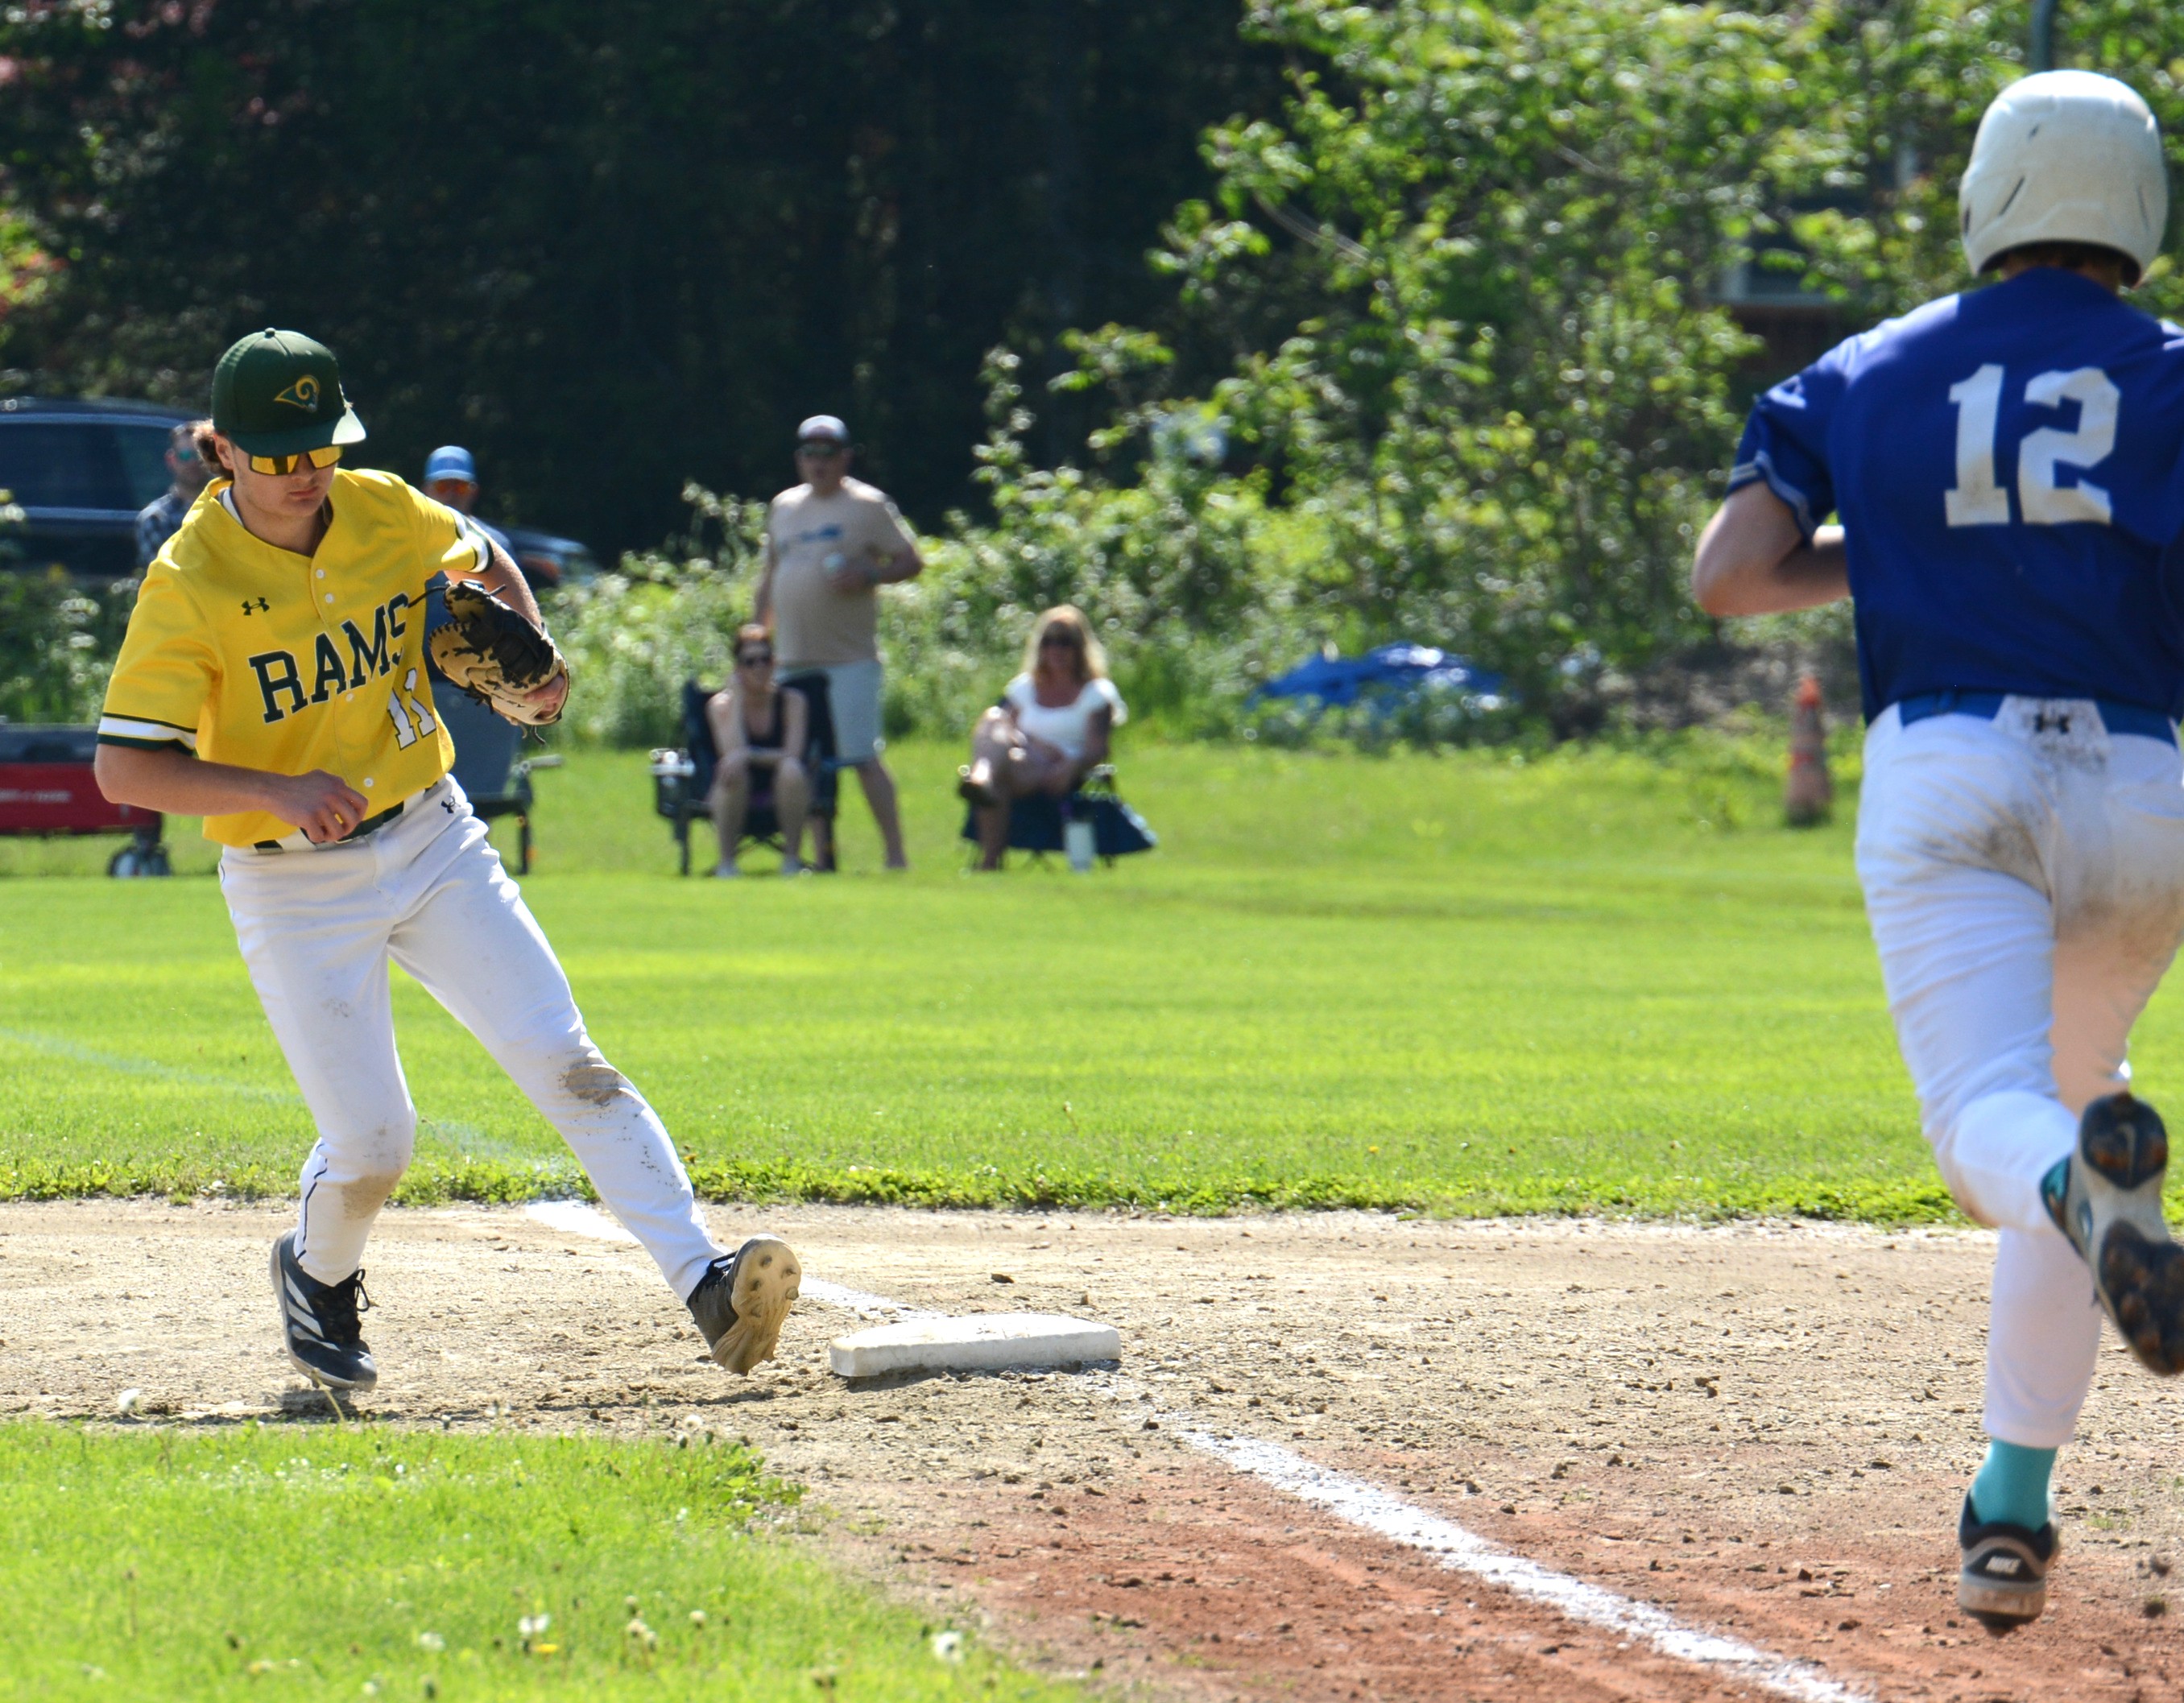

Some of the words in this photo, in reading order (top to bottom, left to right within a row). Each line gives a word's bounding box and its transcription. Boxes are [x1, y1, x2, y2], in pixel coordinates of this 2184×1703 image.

[1944, 362, 2121, 528] 12
[248, 593, 409, 723] RAMS
[387, 668, 436, 750] 11
